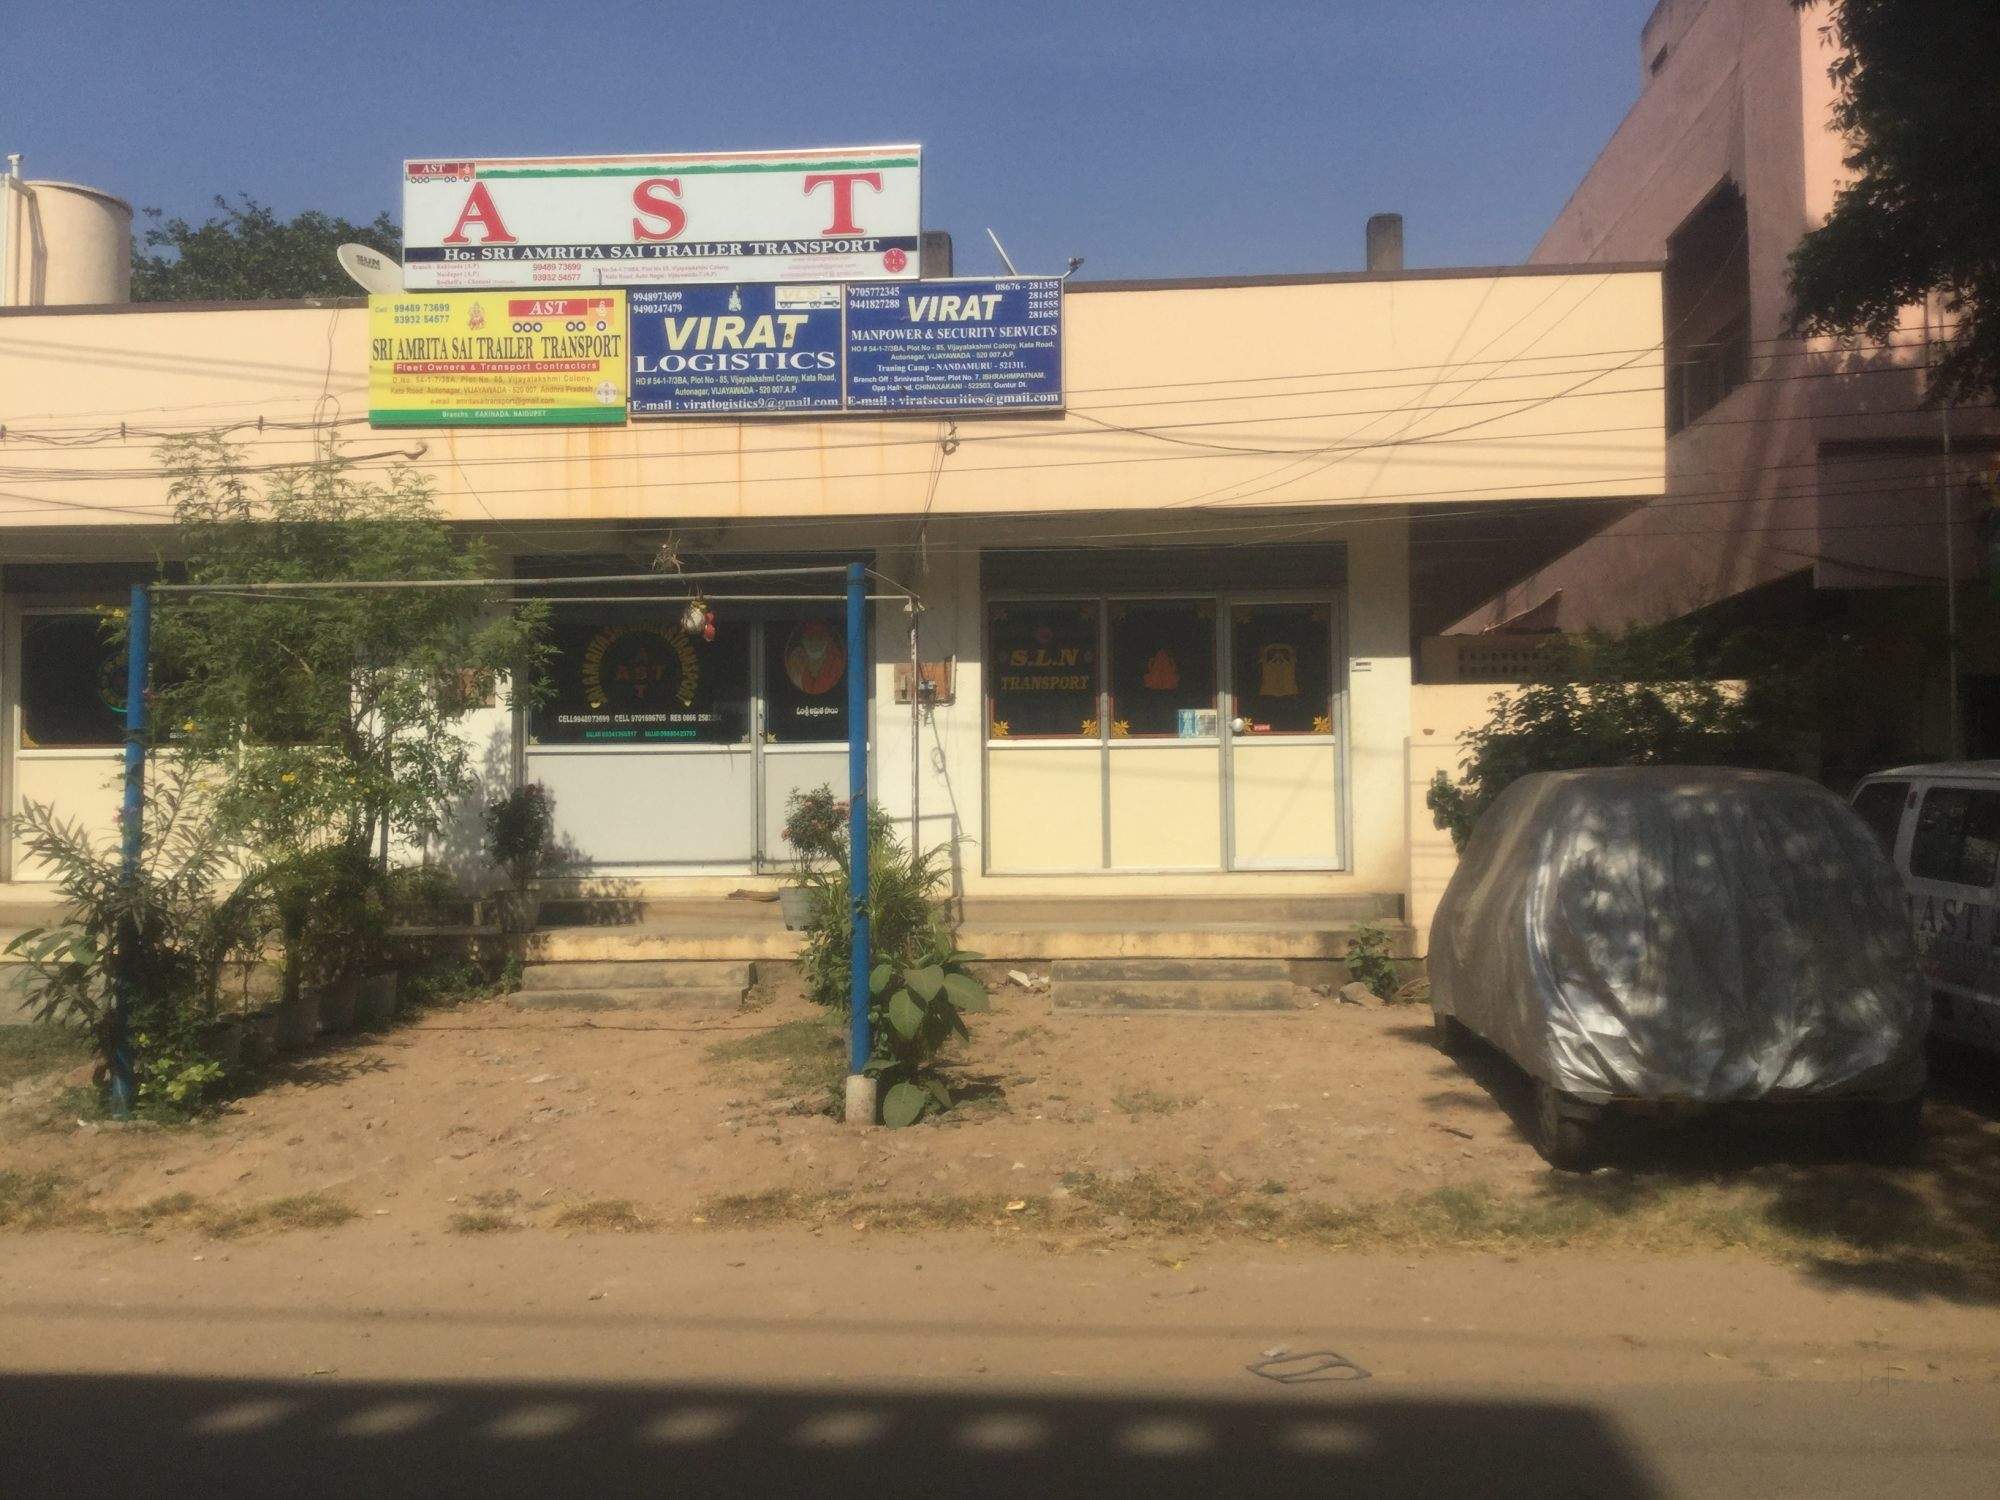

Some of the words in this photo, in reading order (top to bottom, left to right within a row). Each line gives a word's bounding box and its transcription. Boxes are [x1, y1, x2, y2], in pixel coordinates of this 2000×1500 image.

[421, 164, 446, 174] AST
[441, 180, 518, 245] A
[631, 177, 688, 243] S
[802, 171, 884, 238] T
[445, 248, 477, 261] Ho:
[481, 247, 519, 261] SRI
[522, 246, 606, 260] AMRITA
[610, 244, 645, 259] SAI
[648, 242, 745, 258] TRAILER
[747, 239, 881, 256] TRANSPORT
[530, 301, 567, 316] AST
[907, 294, 1003, 322] VIRAT
[664, 314, 809, 350] VIRAT
[852, 328, 922, 340] MANPOWER
[924, 329, 934, 340] &
[937, 326, 998, 340] SECURITY
[1000, 324, 1058, 337] SERVICES
[372, 338, 393, 360] SRI
[398, 337, 448, 360] AMRITA
[452, 336, 472, 360] SAI
[476, 336, 534, 360] TRAILER
[541, 334, 621, 358] TRANSPORT
[396, 364, 423, 372] Fleet
[428, 363, 466, 372] Owners
[480, 362, 530, 372] Transport
[536, 361, 598, 370] Contractors
[635, 352, 836, 373] LOGISTICS
[936, 362, 993, 370] NANDAMURU
[632, 400, 672, 410] E-mail
[683, 397, 838, 411] viratlogistics9@gmailcom
[1000, 676, 1089, 690] TRANSPORT
